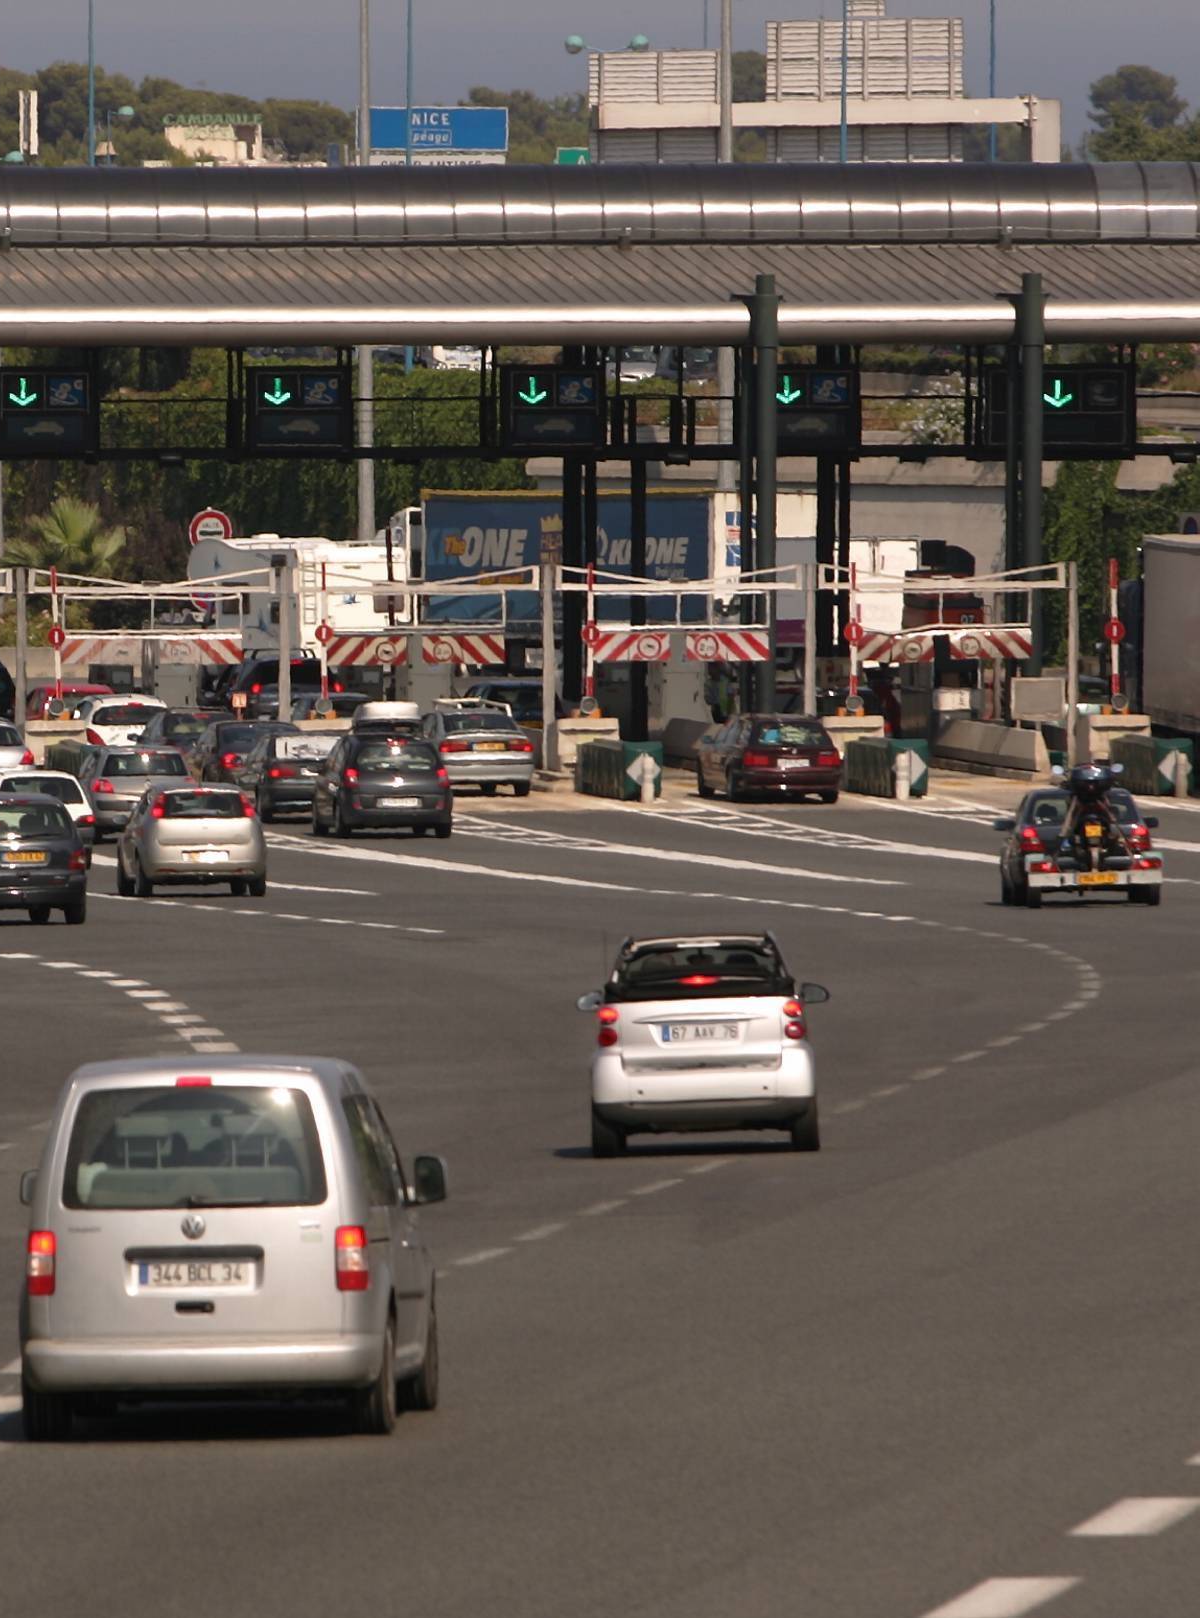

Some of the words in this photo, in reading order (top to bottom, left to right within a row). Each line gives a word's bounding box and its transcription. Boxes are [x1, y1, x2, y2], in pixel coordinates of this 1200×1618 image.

[162, 113, 263, 125] CAMPANILE
[411, 112, 450, 126] NICE
[412, 129, 449, 143] péage
[152, 1264, 182, 1282] 344
[188, 1263, 216, 1282] BCL
[223, 1263, 242, 1281] 34
